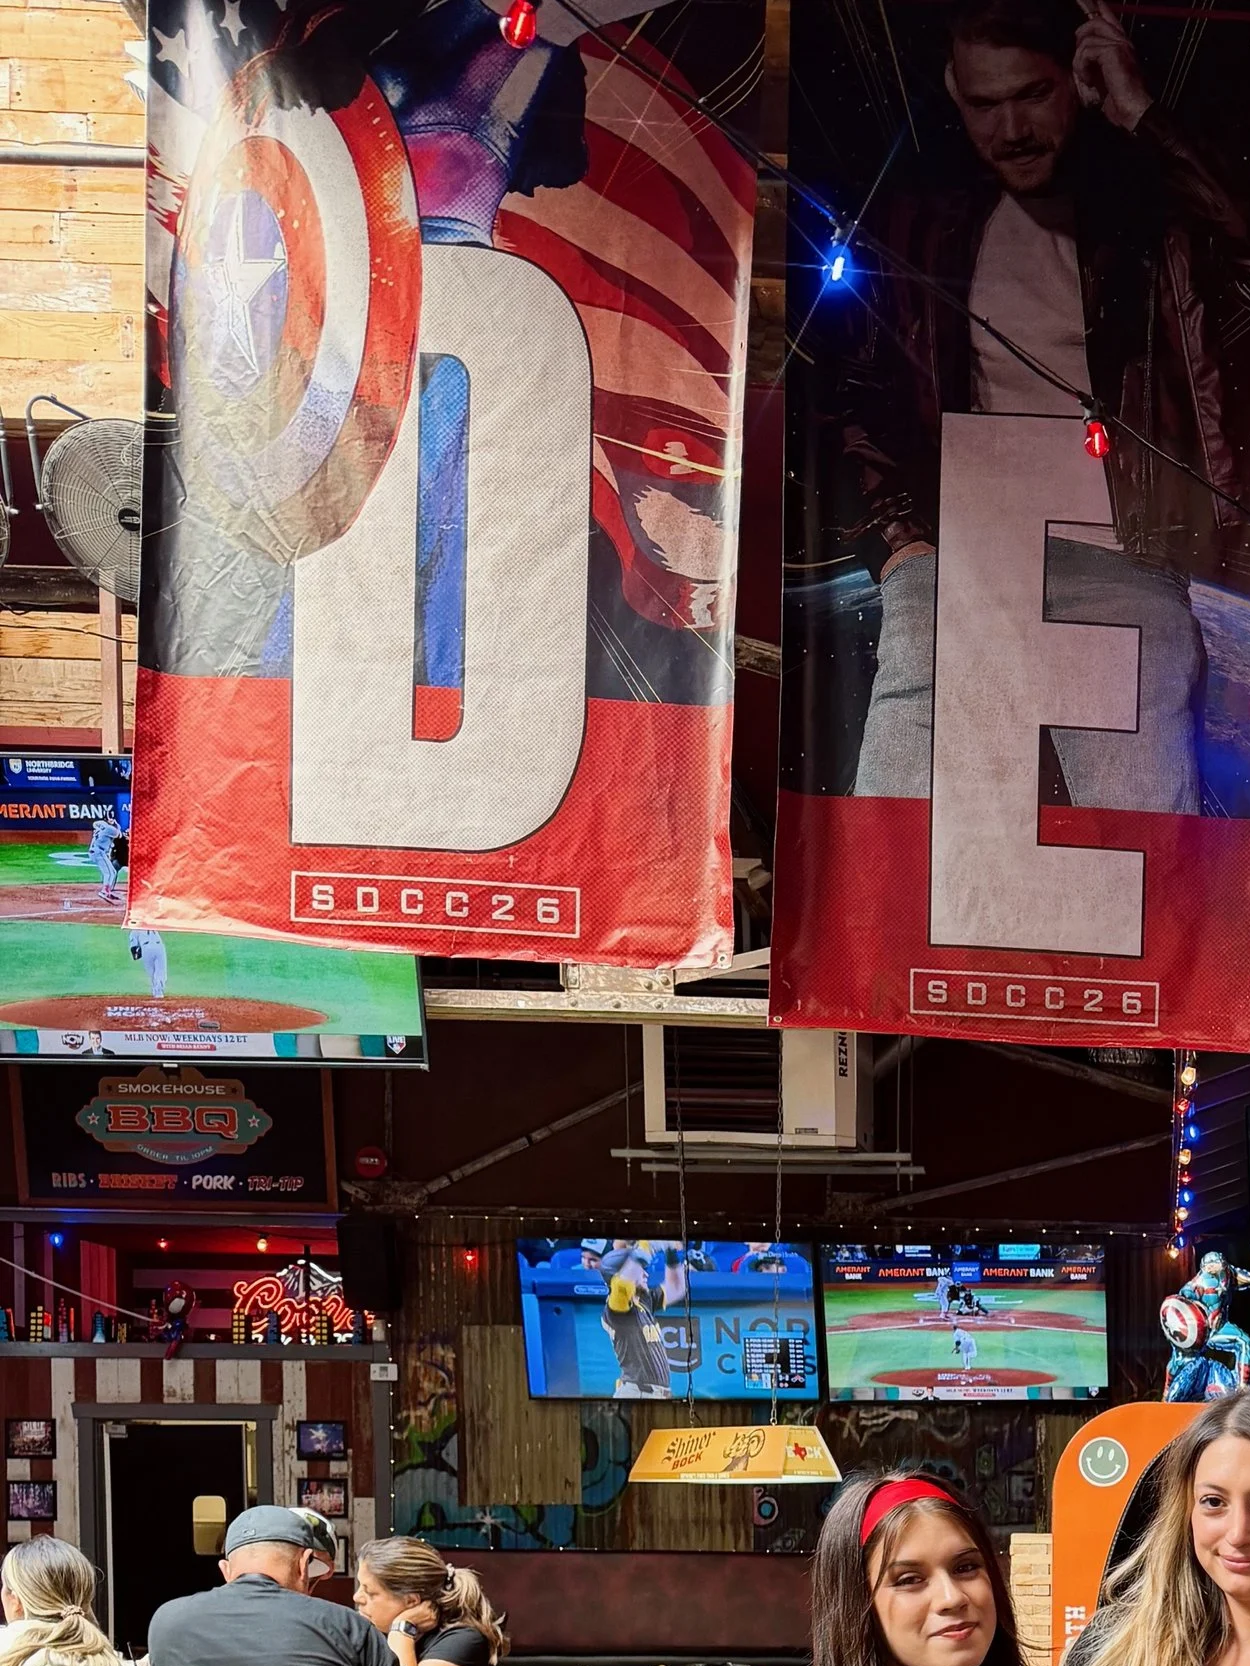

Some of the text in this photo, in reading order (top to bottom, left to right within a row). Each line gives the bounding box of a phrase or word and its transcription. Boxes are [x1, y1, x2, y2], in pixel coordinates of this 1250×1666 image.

[288, 242, 595, 854] D
[928, 411, 1146, 958] E
[173, 1034, 223, 1043] WEEKDAYS
[118, 1083, 227, 1095] SMOKEHOUSE
[105, 1103, 239, 1139] BBQ
[52, 1171, 87, 1189] RIBS
[191, 1174, 236, 1190] PORK
[247, 1175, 305, 1192] TRI-TIP
[1029, 1268, 1055, 1278] BANK
[661, 1431, 717, 1465] Shiner
[671, 1452, 703, 1471] BOCK
